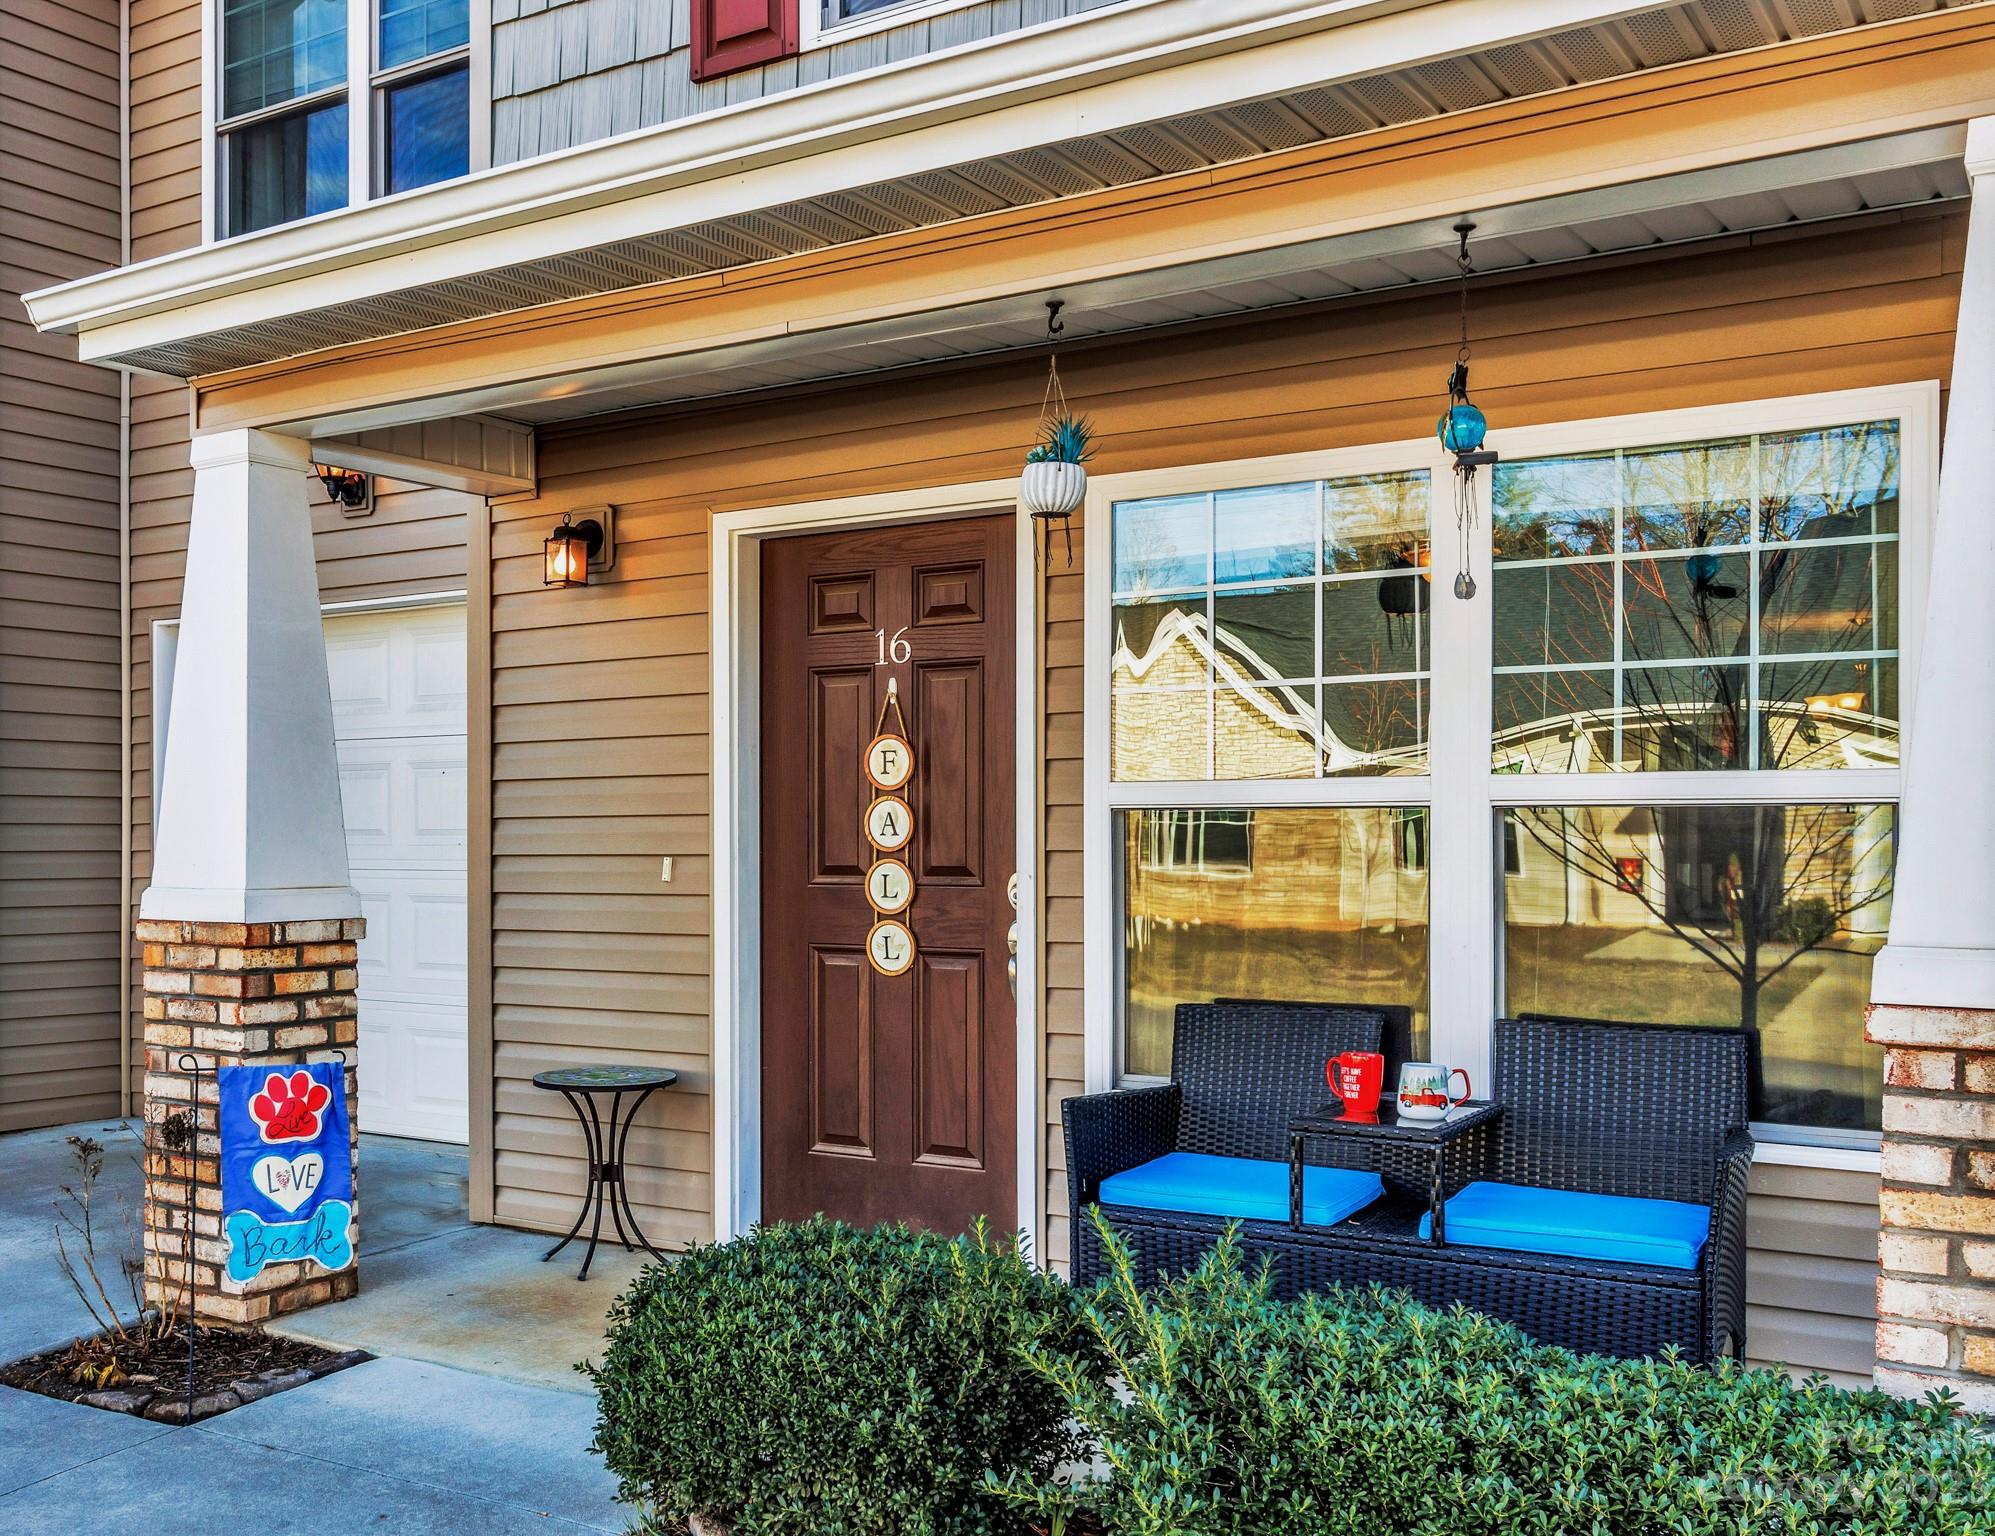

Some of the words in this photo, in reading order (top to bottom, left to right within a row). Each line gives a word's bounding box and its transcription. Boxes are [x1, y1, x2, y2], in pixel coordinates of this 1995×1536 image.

[874, 625, 912, 666] 16
[1344, 1075, 1357, 1083] COFFEE
[1351, 1067, 1361, 1075] HAVE
[269, 1101, 313, 1138] Live
[241, 1213, 340, 1268] Bark
